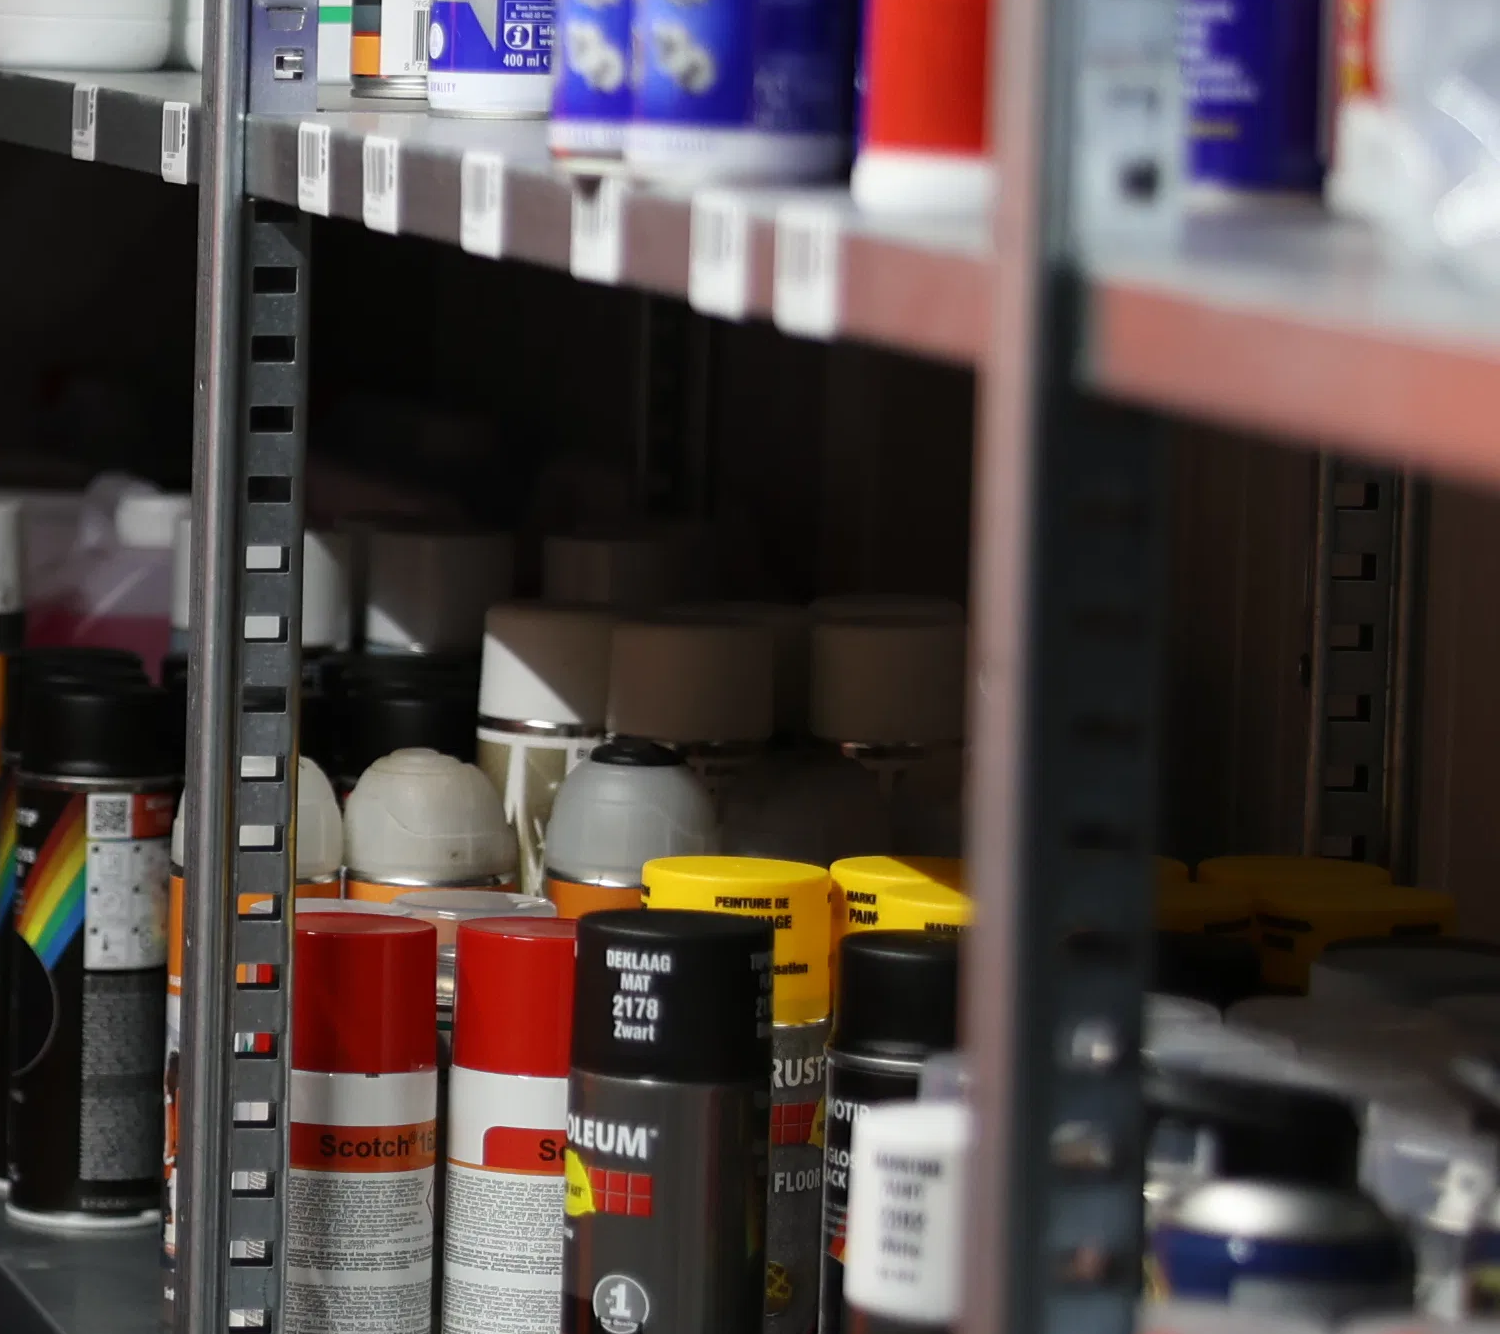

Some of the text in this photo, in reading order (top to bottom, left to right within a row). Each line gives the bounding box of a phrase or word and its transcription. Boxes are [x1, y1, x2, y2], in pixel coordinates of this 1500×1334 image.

[503, 53, 539, 67] 400 ml
[714, 896, 790, 910] PEINTURE DE
[605, 949, 672, 973] DEKLAAG
[619, 972, 651, 993] MAT
[612, 995, 660, 1021] 2178
[613, 1020, 655, 1042] Zwart
